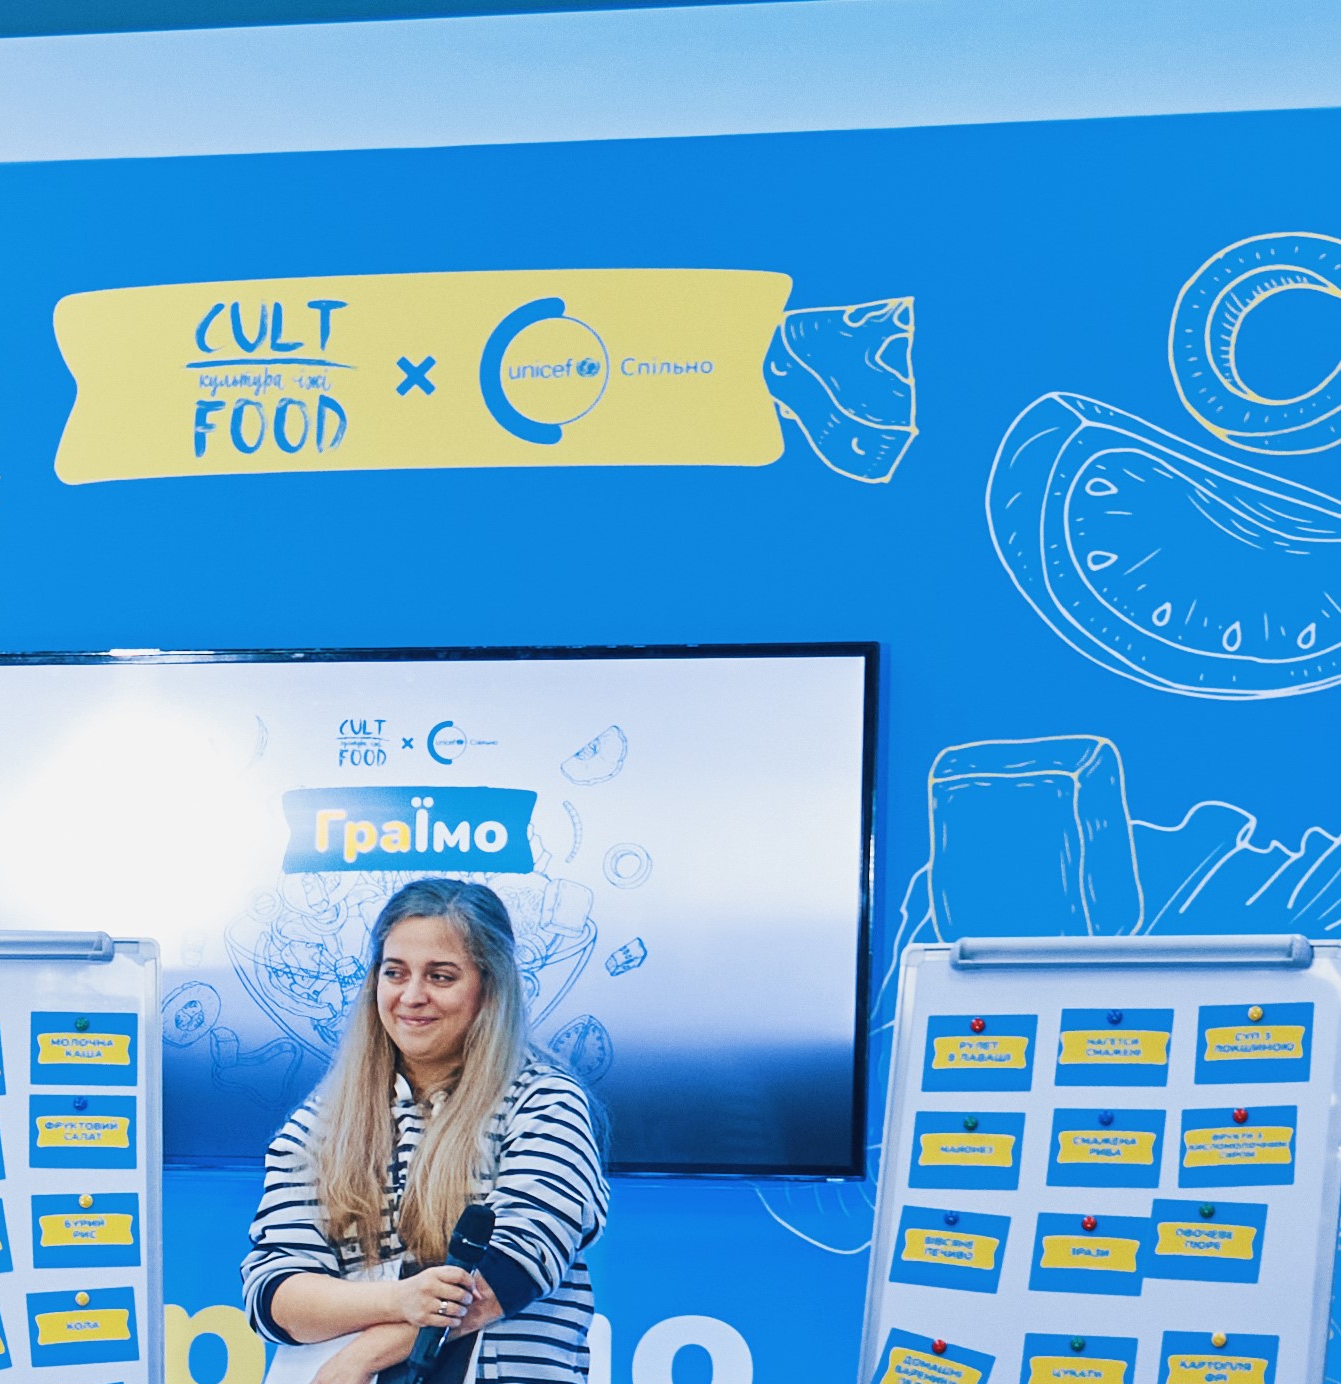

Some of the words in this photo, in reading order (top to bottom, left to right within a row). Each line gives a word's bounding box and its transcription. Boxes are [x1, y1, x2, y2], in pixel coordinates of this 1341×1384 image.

[194, 299, 349, 353] CULT
[508, 357, 573, 381] unicef
[621, 356, 714, 380] Спільно
[194, 395, 348, 458] FOOD
[339, 718, 386, 735] CULT
[338, 749, 387, 767] FOOD
[315, 796, 508, 863] ГраЇмо
[50, 1038, 114, 1047] МОЛОЧНА
[65, 1049, 103, 1058] КАША
[44, 1121, 119, 1131] ФРУКТОВИЙ
[63, 1132, 102, 1141] САЛАТ
[1089, 1148, 1122, 1157] РИБА
[72, 1230, 97, 1239] РИС
[65, 1321, 101, 1331] КОЛА
[1179, 1360, 1252, 1371] КАРТОПЛЯ
